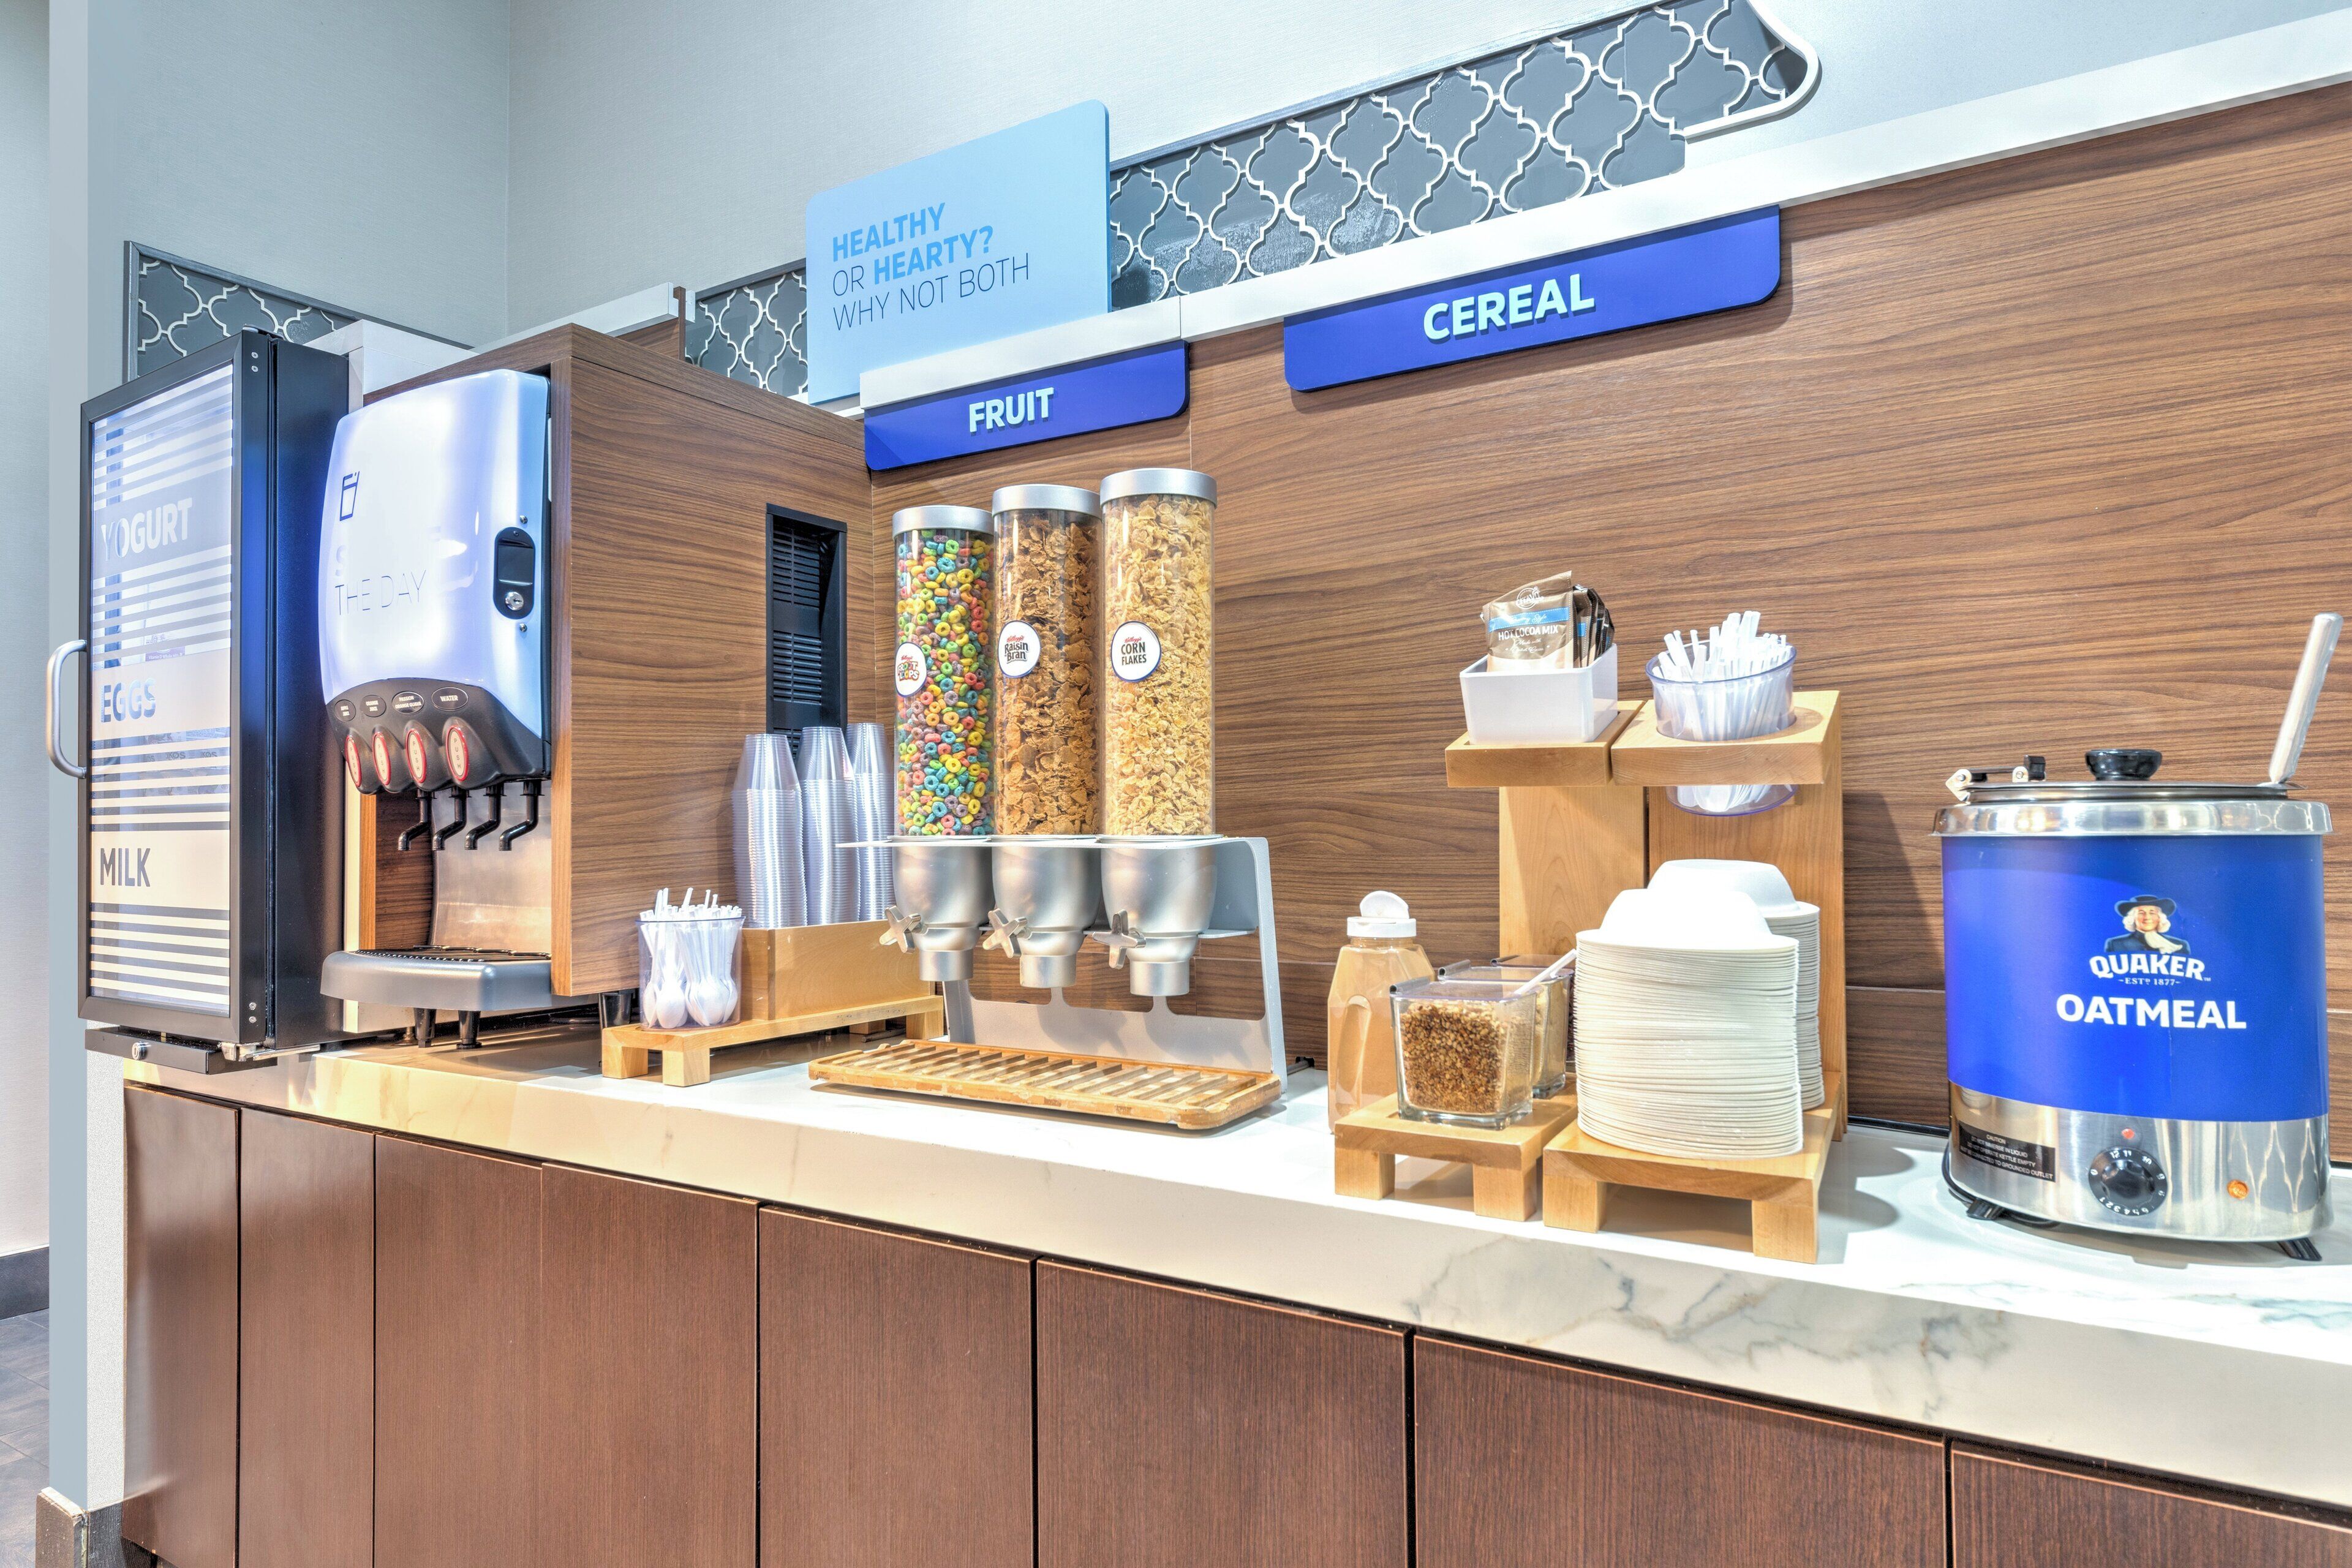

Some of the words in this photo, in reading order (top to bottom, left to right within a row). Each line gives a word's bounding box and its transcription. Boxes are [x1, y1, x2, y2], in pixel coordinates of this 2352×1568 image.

[832, 203, 946, 262] HEALTHY
[832, 265, 864, 296] OR
[873, 225, 993, 285] HEARTY?
[833, 293, 889, 331] WHY
[900, 276, 949, 314] NOT
[960, 252, 1029, 298] BOTH
[1423, 273, 1595, 341] CEREAL
[969, 387, 1054, 432] FRUIT
[101, 497, 193, 562] YOGURT
[335, 579, 371, 615] THE
[381, 570, 426, 608] DAY
[1515, 627, 1541, 638] COCOA
[1542, 625, 1559, 635] MIX
[1005, 642, 1029, 654] Raisin
[1006, 651, 1027, 662] Bran
[1121, 641, 1145, 655] CORN
[1121, 654, 1147, 666] FLAKES
[101, 678, 156, 722] EGGS
[100, 848, 151, 887] MILK
[2089, 954, 2205, 981] QUAKER
[2056, 993, 2247, 1029] OATMEAL
[1986, 1134, 2006, 1144] CAUTION
[2011, 1148, 2028, 1158] LIQUID
[1999, 1153, 2017, 1163] KETTLE
[2018, 1158, 2035, 1167] EMPTY
[2002, 1161, 2030, 1174] GROUNDED
[2030, 1170, 2053, 1180] OUTLET
